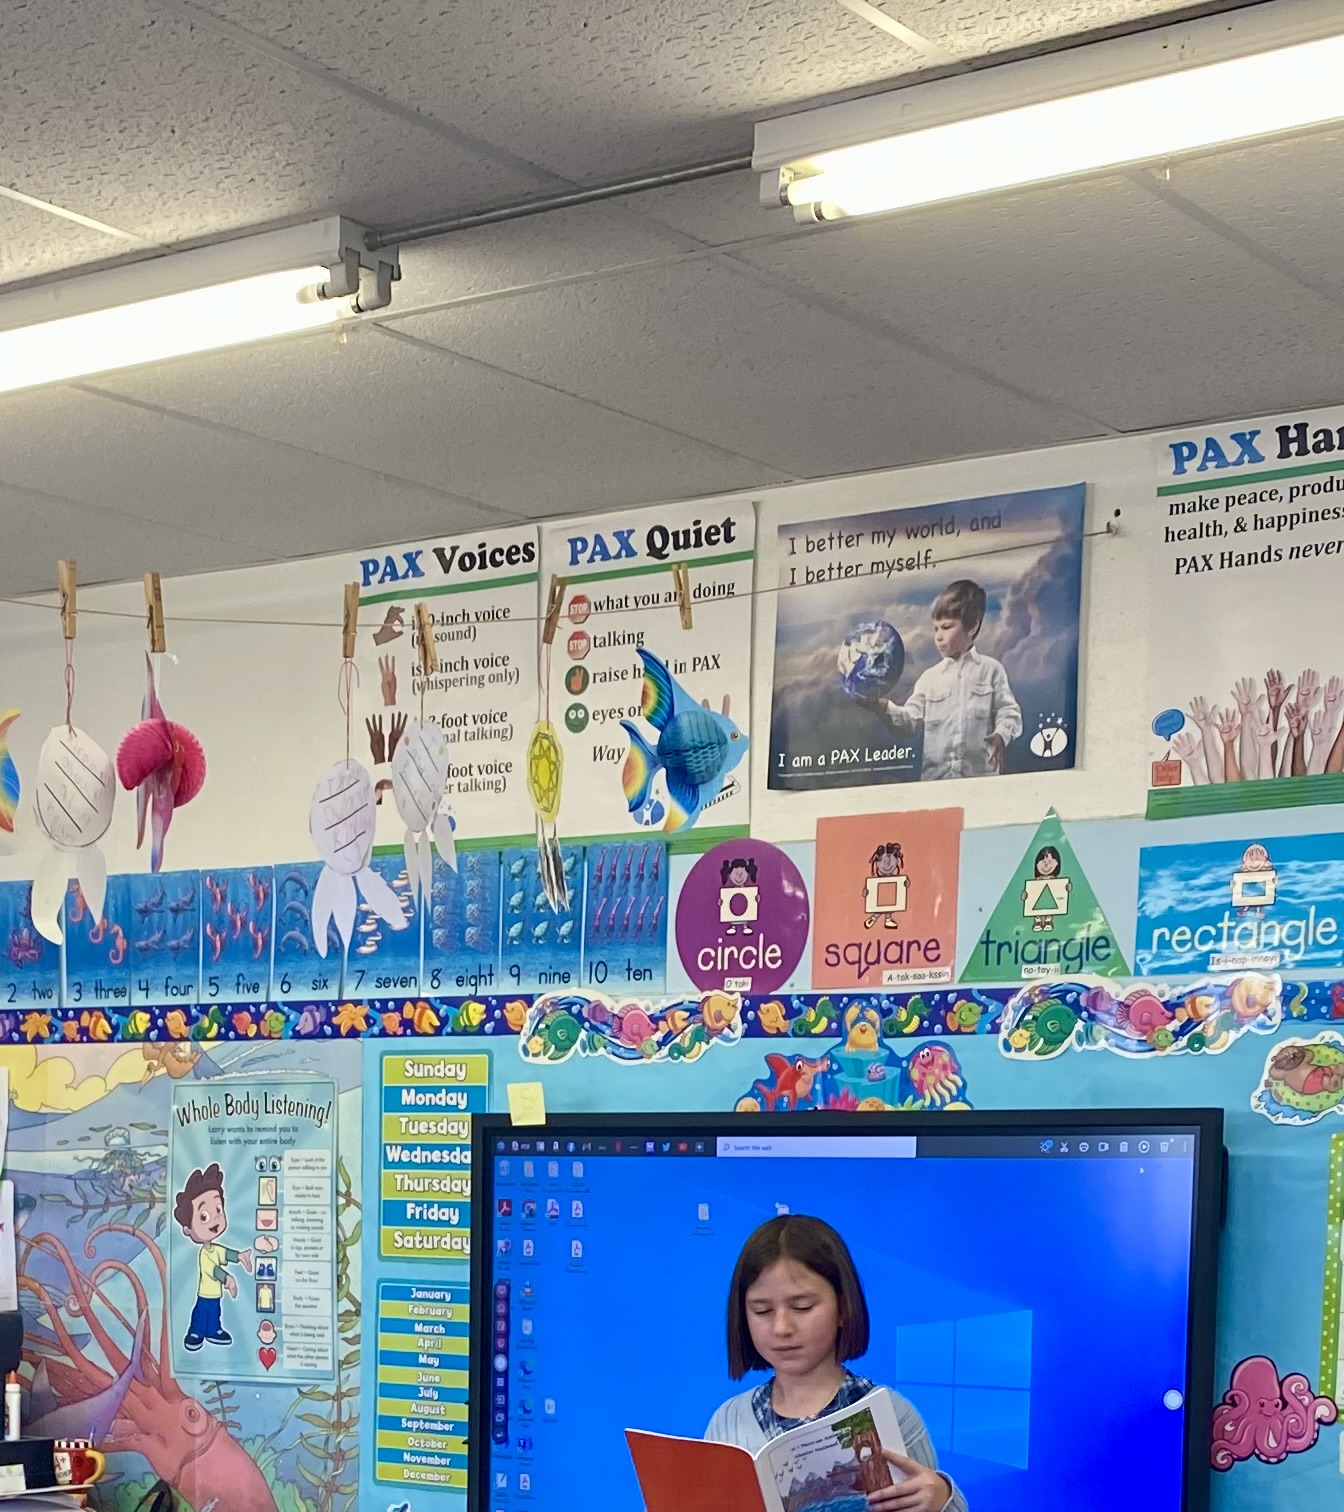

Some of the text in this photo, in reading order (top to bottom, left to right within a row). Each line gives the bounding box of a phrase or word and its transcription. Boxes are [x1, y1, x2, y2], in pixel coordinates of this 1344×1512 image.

[1169, 430, 1265, 475] PAX
[1168, 496, 1220, 516] make
[1225, 488, 1283, 512] peace,
[568, 517, 736, 566] PAX Quiet
[789, 511, 1001, 555] I better my world, and
[1164, 520, 1228, 543] health,
[361, 541, 536, 587] PAX Voices
[789, 550, 936, 586] I better myself.
[1174, 553, 1214, 575] PAX
[1219, 545, 1283, 569] Hands
[594, 580, 735, 613] what you doing
[593, 629, 644, 650] talking
[412, 668, 520, 696] (whispering only)
[592, 706, 623, 724] eyes
[593, 746, 626, 764] Way
[792, 745, 916, 766] am PAX Leader.
[1151, 910, 1339, 966] rectangle
[697, 938, 784, 971] circle
[823, 933, 942, 978] square
[980, 928, 1112, 973] triangle
[455, 964, 494, 996] eight
[539, 965, 571, 985] nine
[626, 958, 653, 983] ten
[32, 982, 53, 1000] two
[95, 981, 127, 999] three
[165, 976, 194, 998] four
[236, 974, 260, 994] five
[311, 974, 329, 991] six
[375, 975, 417, 989] seven
[404, 1060, 467, 1081] Sunday
[177, 1091, 332, 1128] Whole Body Listening!
[401, 1089, 468, 1109] Monday
[400, 1118, 469, 1138] Tuesday
[395, 1174, 471, 1196] Thursday
[406, 1203, 459, 1224] Friday
[411, 1288, 451, 1301] January
[419, 1354, 439, 1367] May
[401, 1418, 454, 1432] September
